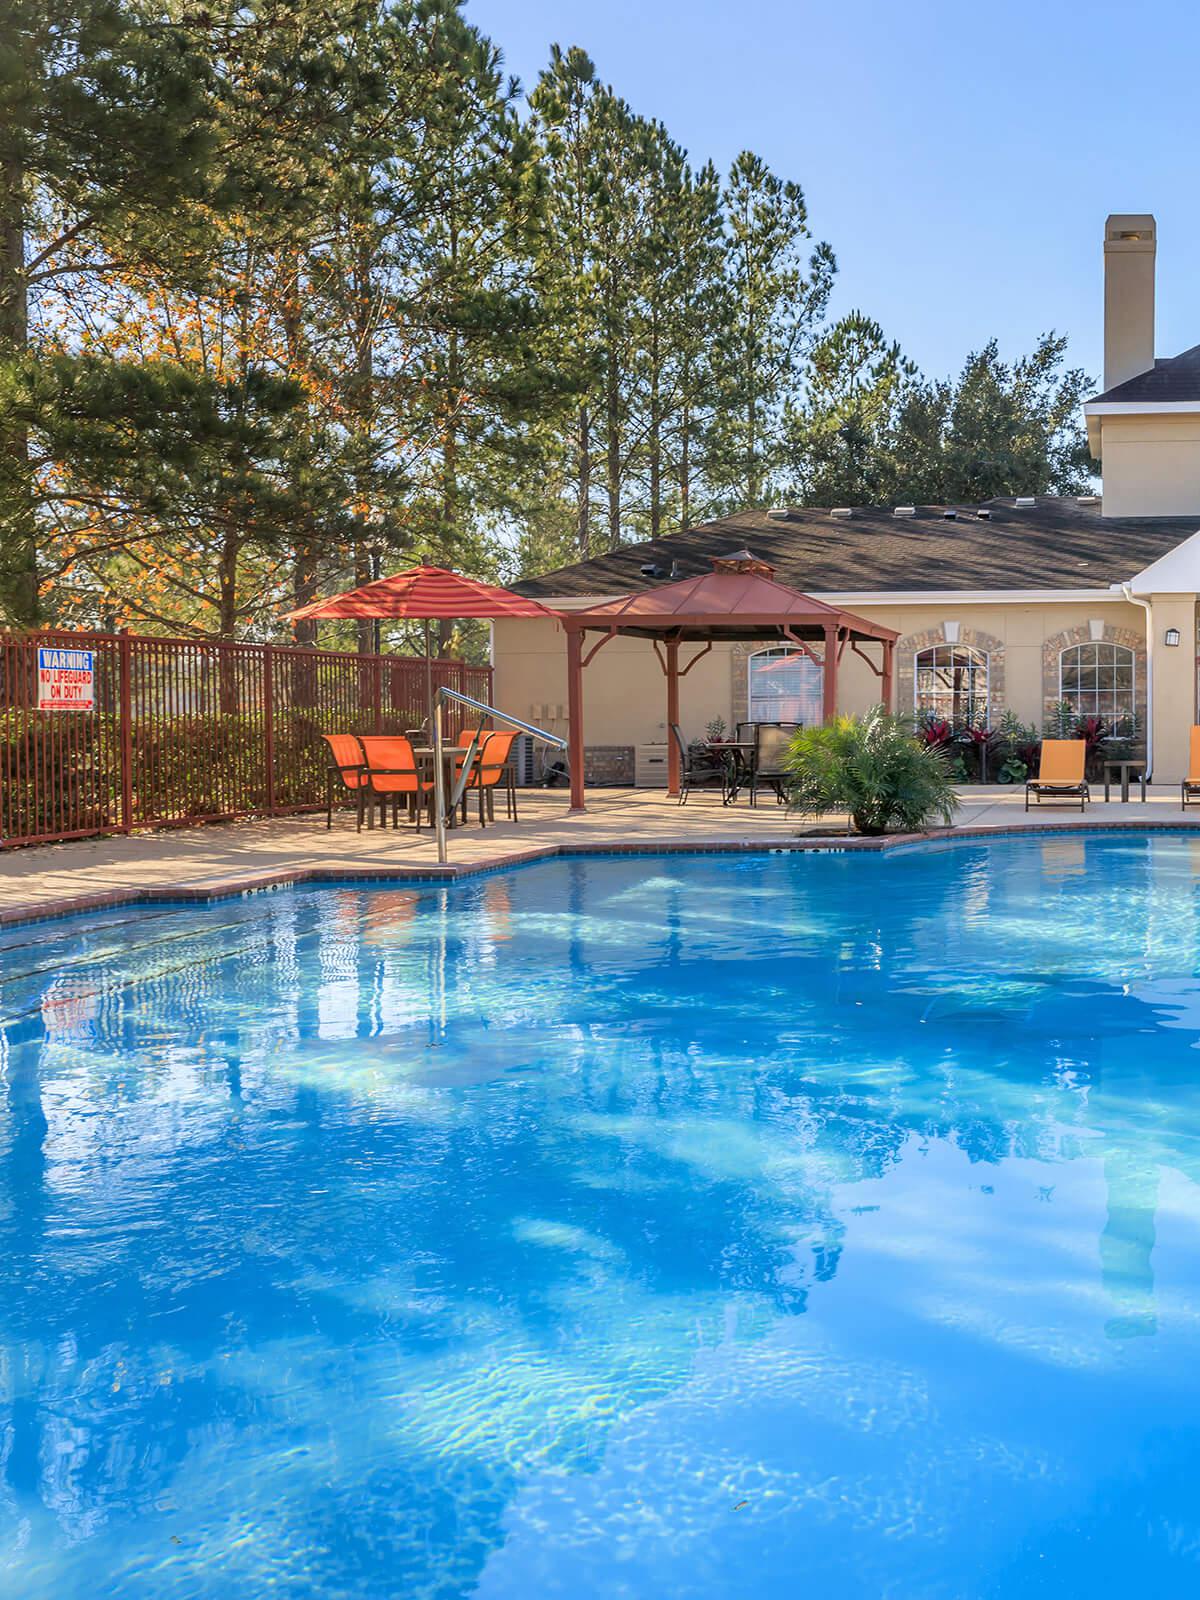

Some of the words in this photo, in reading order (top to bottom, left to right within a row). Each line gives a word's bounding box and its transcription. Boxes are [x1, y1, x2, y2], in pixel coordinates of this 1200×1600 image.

[43, 651, 89, 669] WARNING
[41, 670, 50, 682] NO
[52, 670, 91, 684] LIFEGUARD
[51, 685, 61, 698] ON
[64, 686, 82, 698] DUTY
